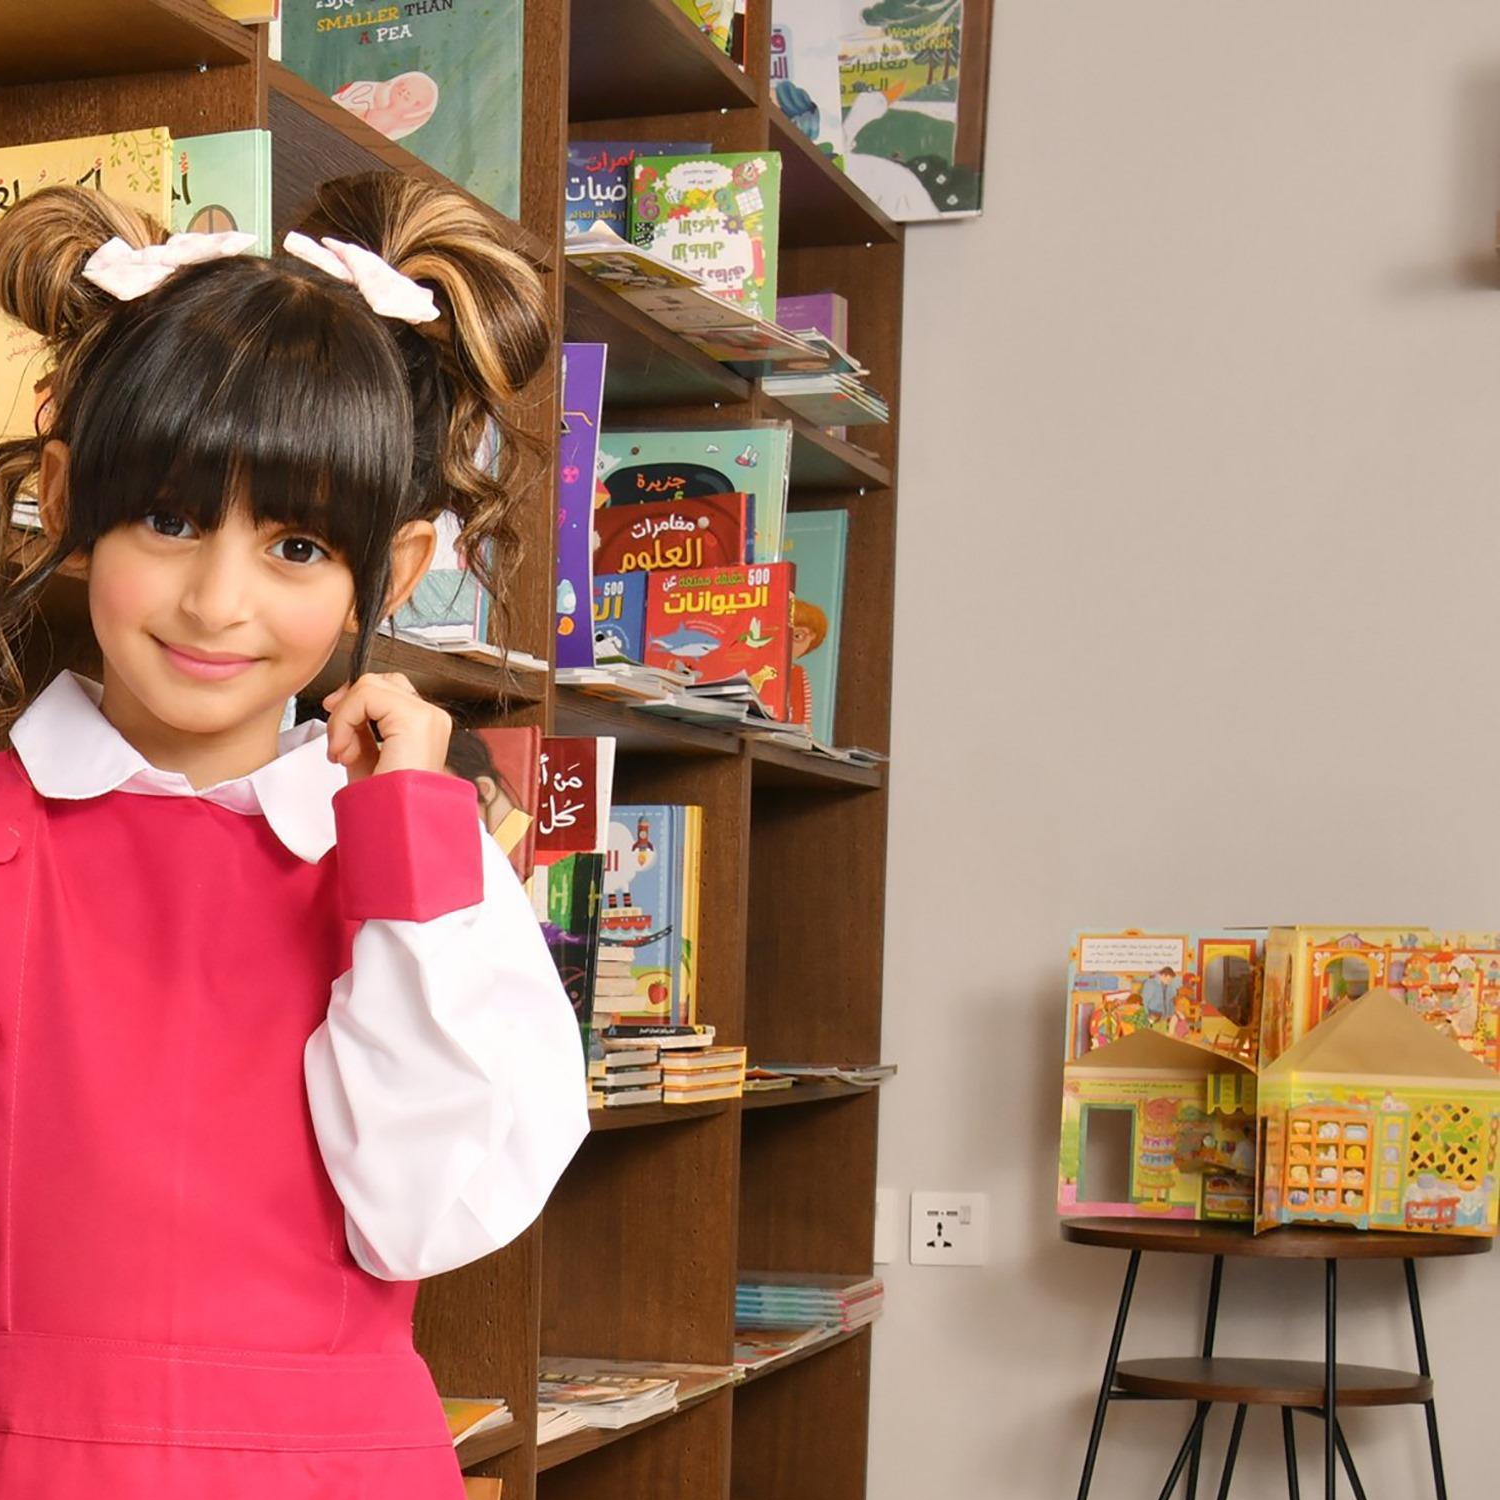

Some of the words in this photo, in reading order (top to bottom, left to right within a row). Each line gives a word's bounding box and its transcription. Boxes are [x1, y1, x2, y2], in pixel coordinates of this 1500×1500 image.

[316, 6, 399, 32] SMALLER
[404, 0, 453, 16] THAN
[359, 31, 372, 45] A
[376, 24, 413, 42] PEA
[636, 473, 687, 492] جزيرة
[631, 513, 696, 541] مغامرات
[617, 537, 703, 574] العلوم
[662, 574, 678, 592] عن
[747, 568, 771, 586] 500
[603, 580, 625, 598] 500
[663, 585, 769, 616] الحيوانات
